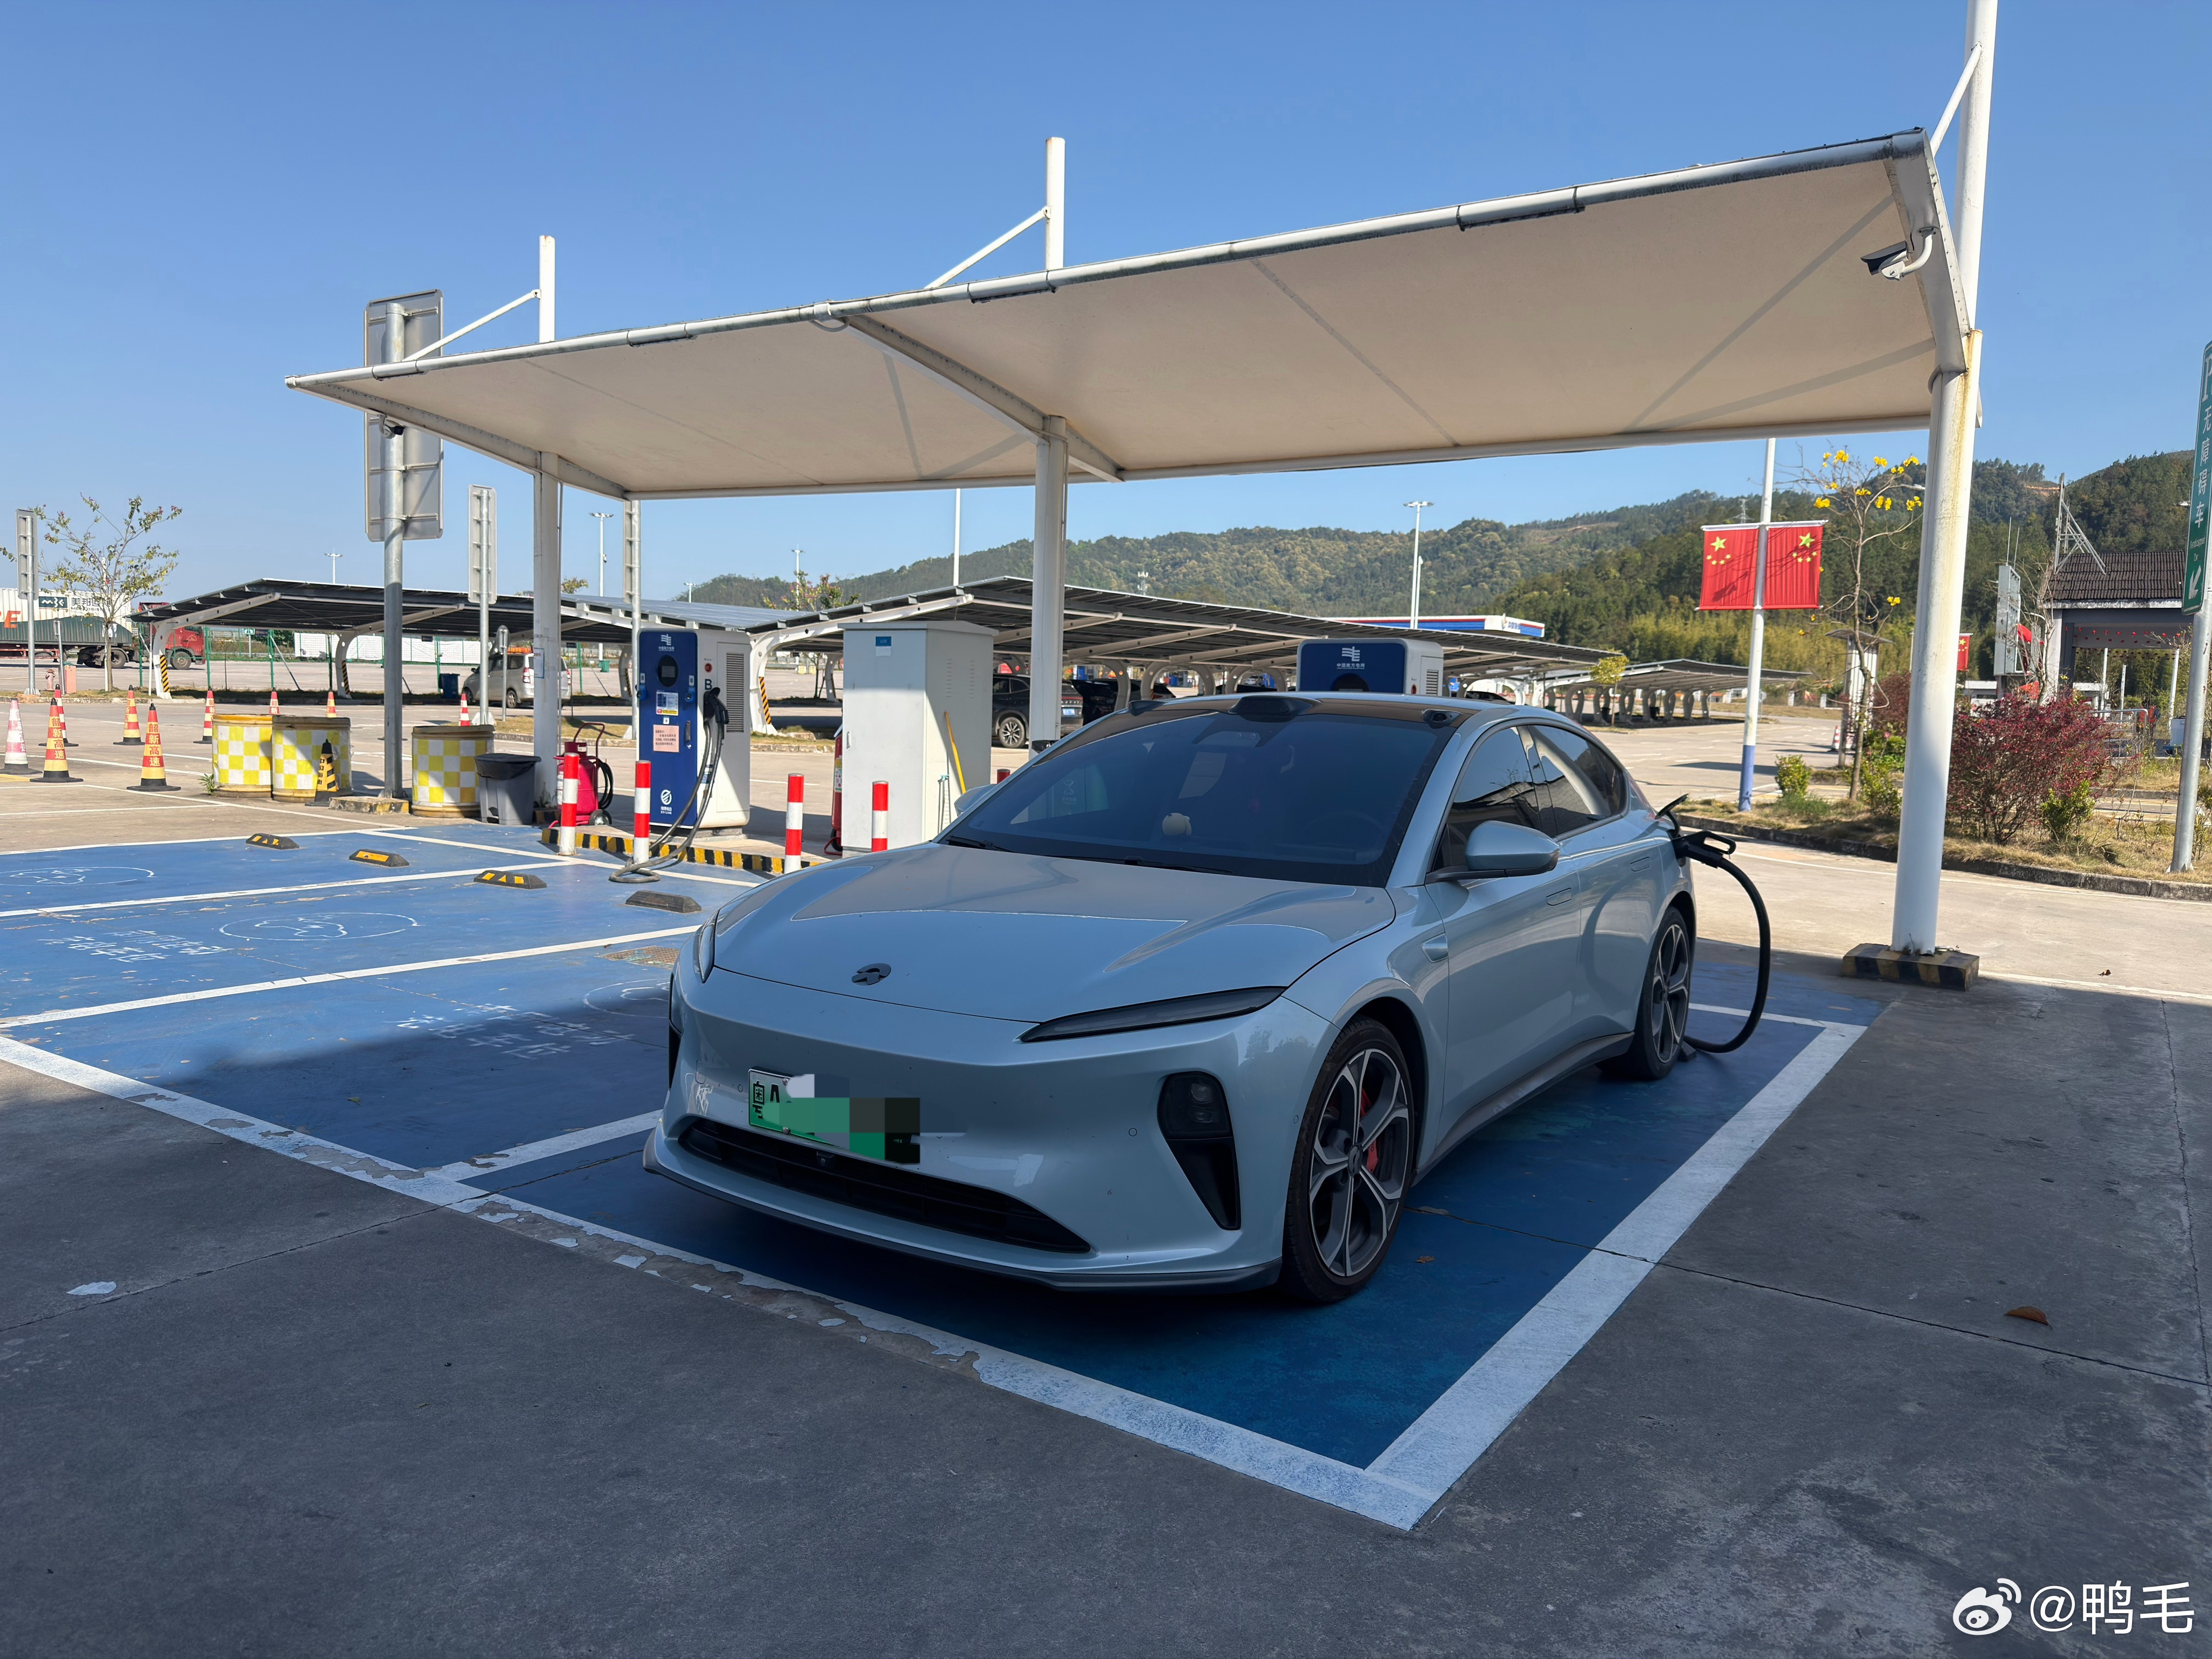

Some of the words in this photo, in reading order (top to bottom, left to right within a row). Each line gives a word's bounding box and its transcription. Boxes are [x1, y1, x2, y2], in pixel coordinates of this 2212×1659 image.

[2195, 406, 2212, 528] 无障碍车
[0, 611, 21, 628] E
[705, 679, 712, 690] B
[149, 723, 160, 766] 韶新高速
